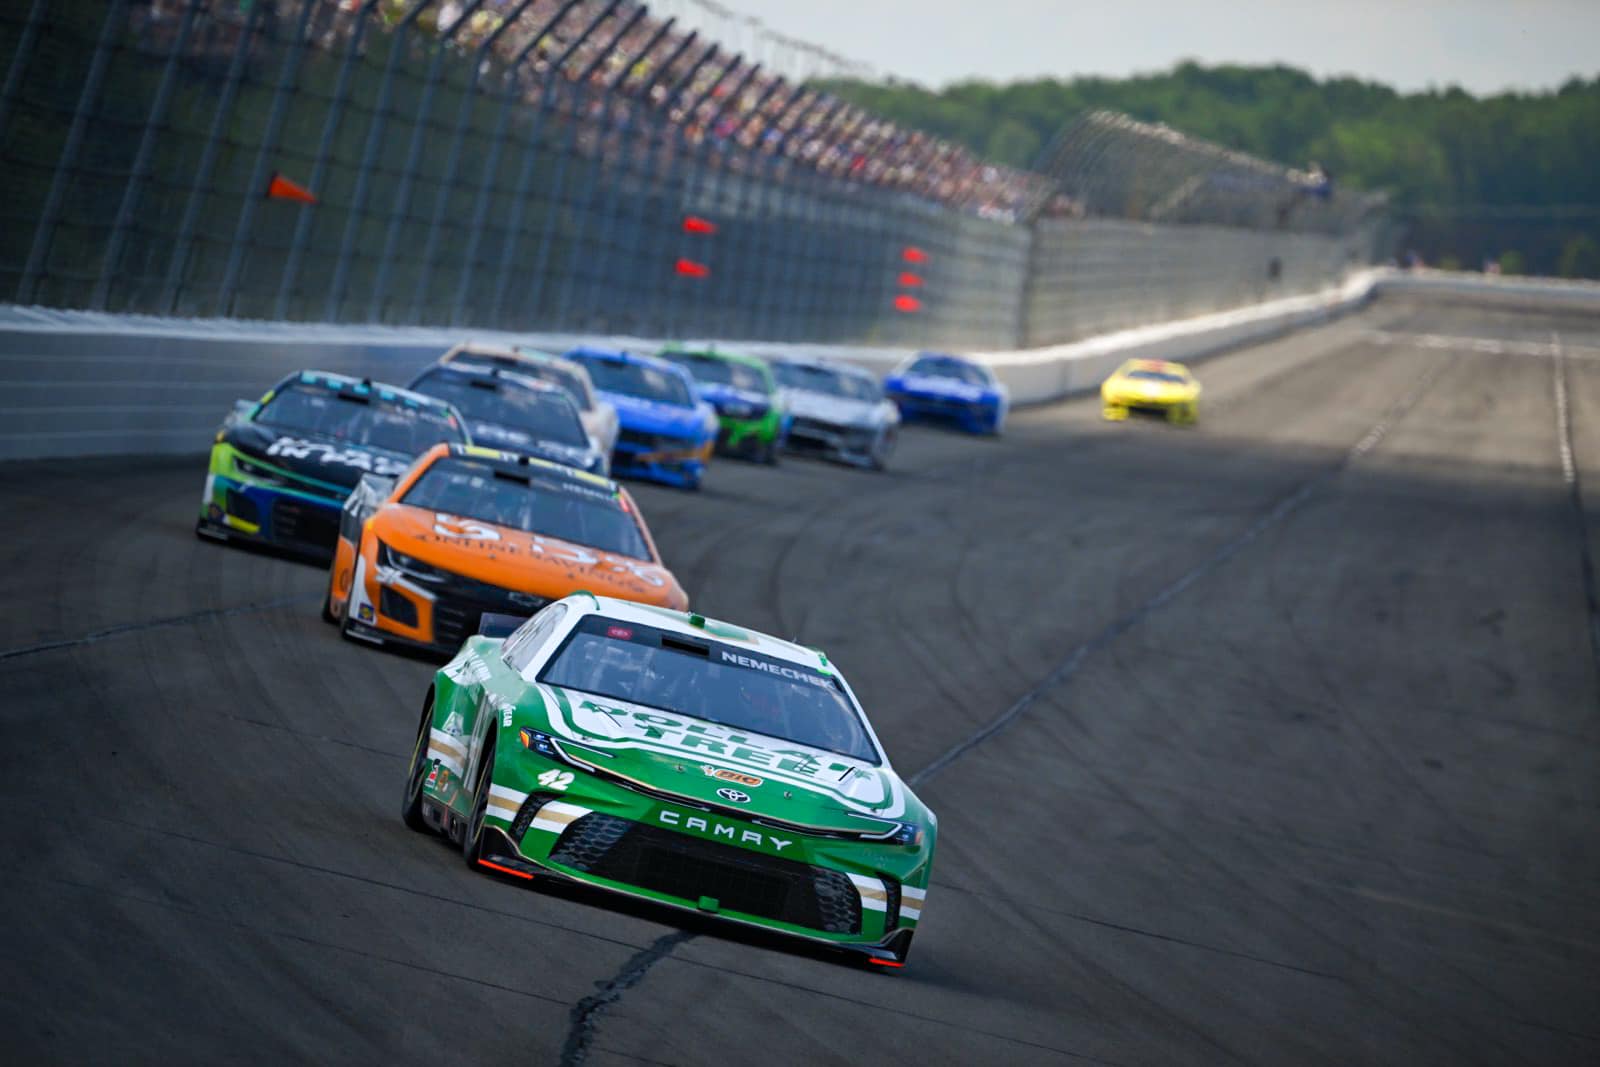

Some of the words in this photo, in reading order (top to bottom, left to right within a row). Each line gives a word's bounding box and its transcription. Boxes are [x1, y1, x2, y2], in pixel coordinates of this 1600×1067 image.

[721, 651, 837, 690] NEMECHEK
[634, 723, 819, 777] TREE
[537, 769, 575, 791] 42
[660, 810, 793, 850] CAMRY
